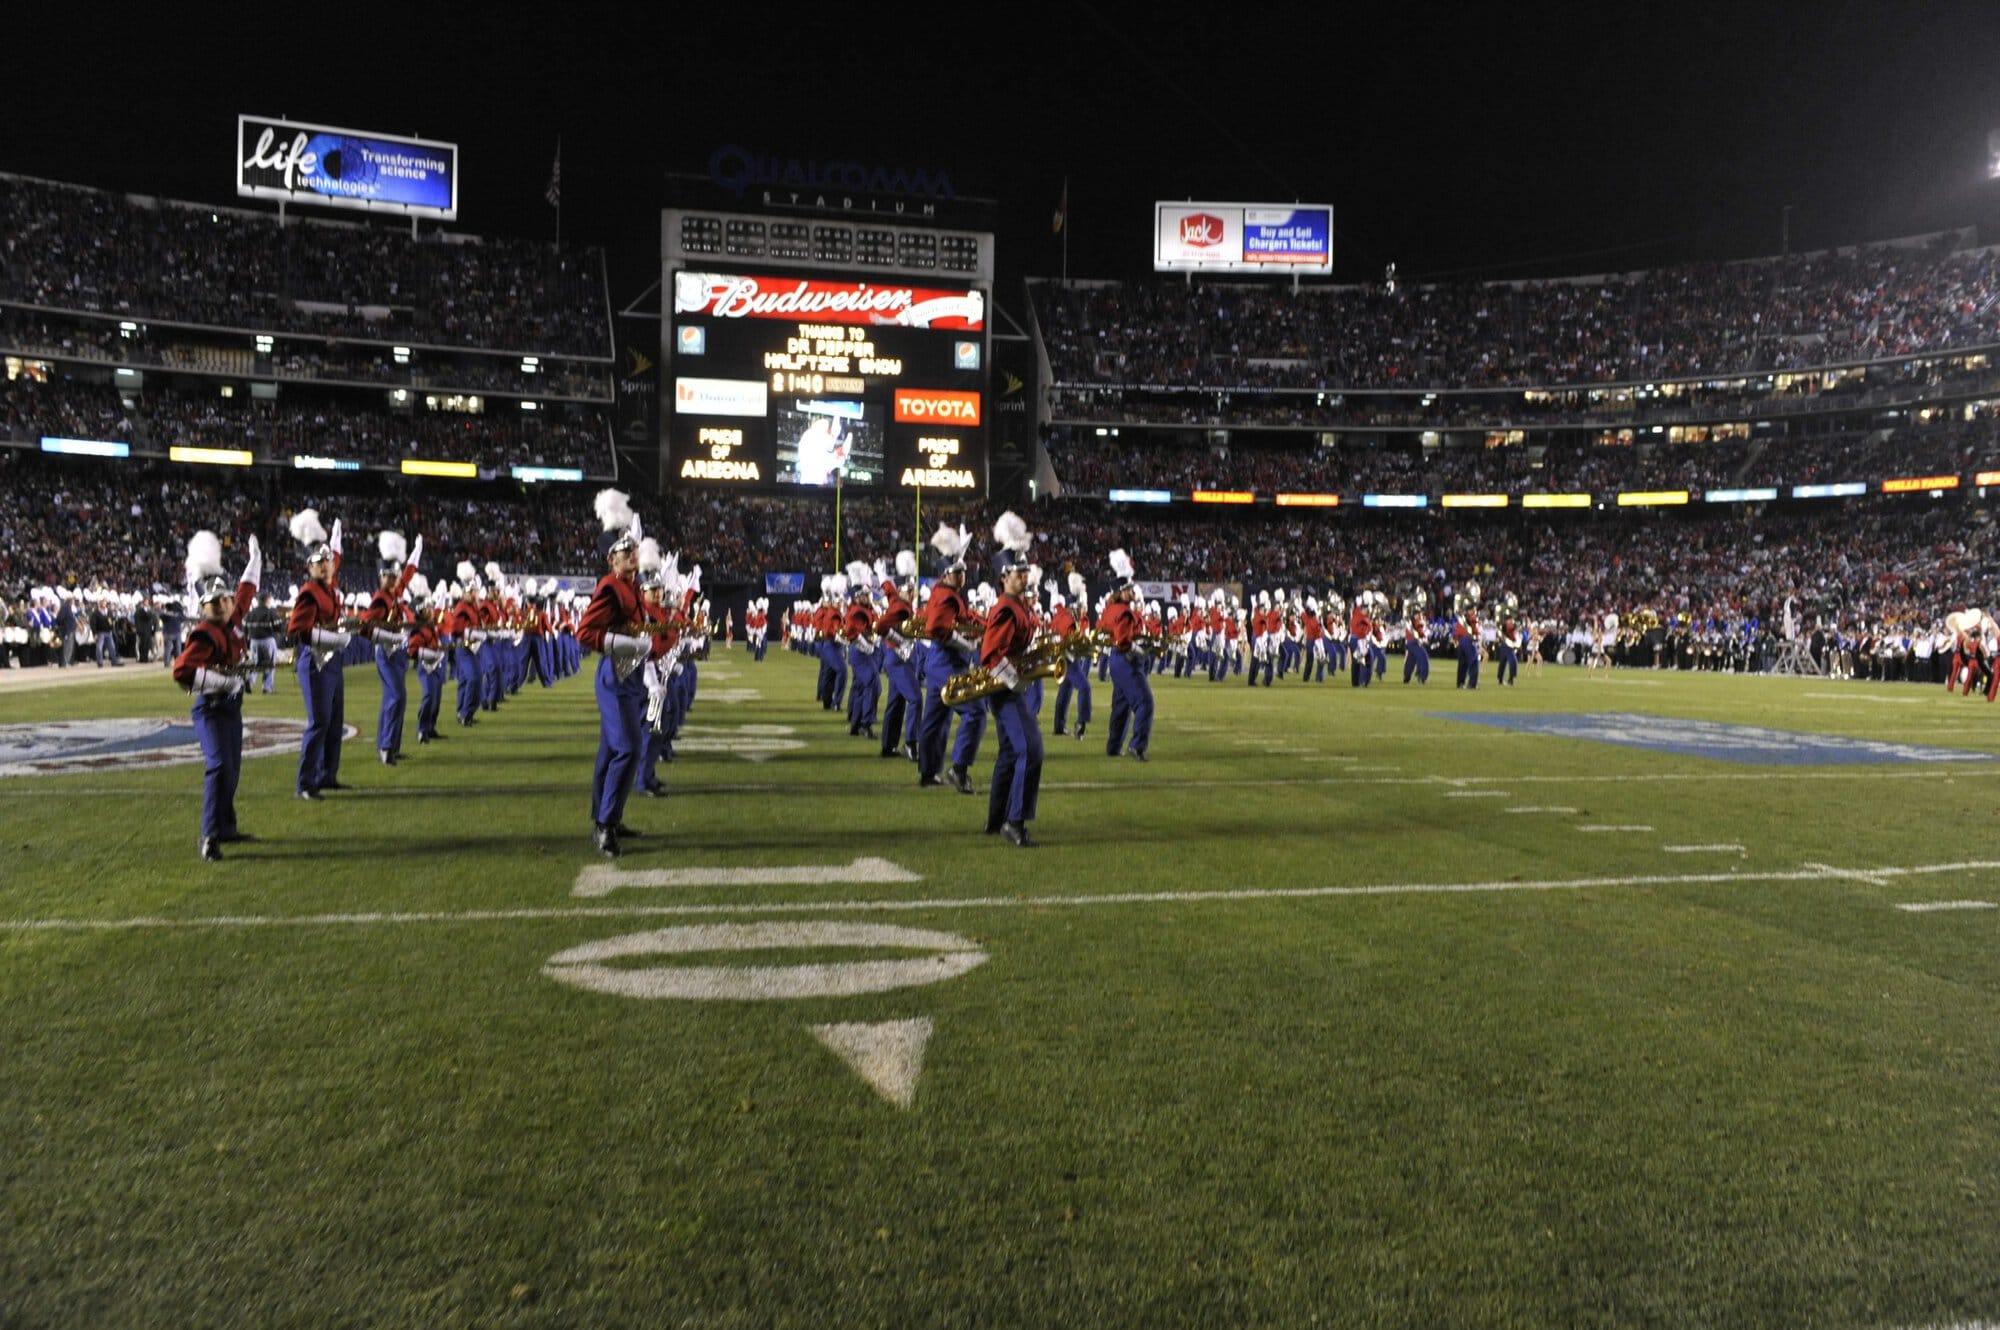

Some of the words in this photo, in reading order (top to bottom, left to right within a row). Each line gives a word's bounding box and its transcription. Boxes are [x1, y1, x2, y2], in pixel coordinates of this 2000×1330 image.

[244, 127, 317, 189] life
[361, 149, 445, 174] Transforming
[380, 166, 426, 180] science
[709, 145, 955, 198] QUALCOMM
[297, 174, 376, 196] technologies
[763, 191, 935, 216] STADIUM
[1278, 227, 1294, 237] and
[1249, 238, 1288, 252] Chargers
[706, 279, 912, 318] Budweiser
[849, 327, 865, 341] TO
[787, 338, 810, 354] DR
[816, 340, 875, 357] PEPPER
[899, 398, 976, 418] TOYOTA
[711, 445, 731, 460] OF
[929, 454, 948, 469] OF
[681, 459, 760, 480] ARIZONA
[901, 468, 975, 488] ARIZONA
